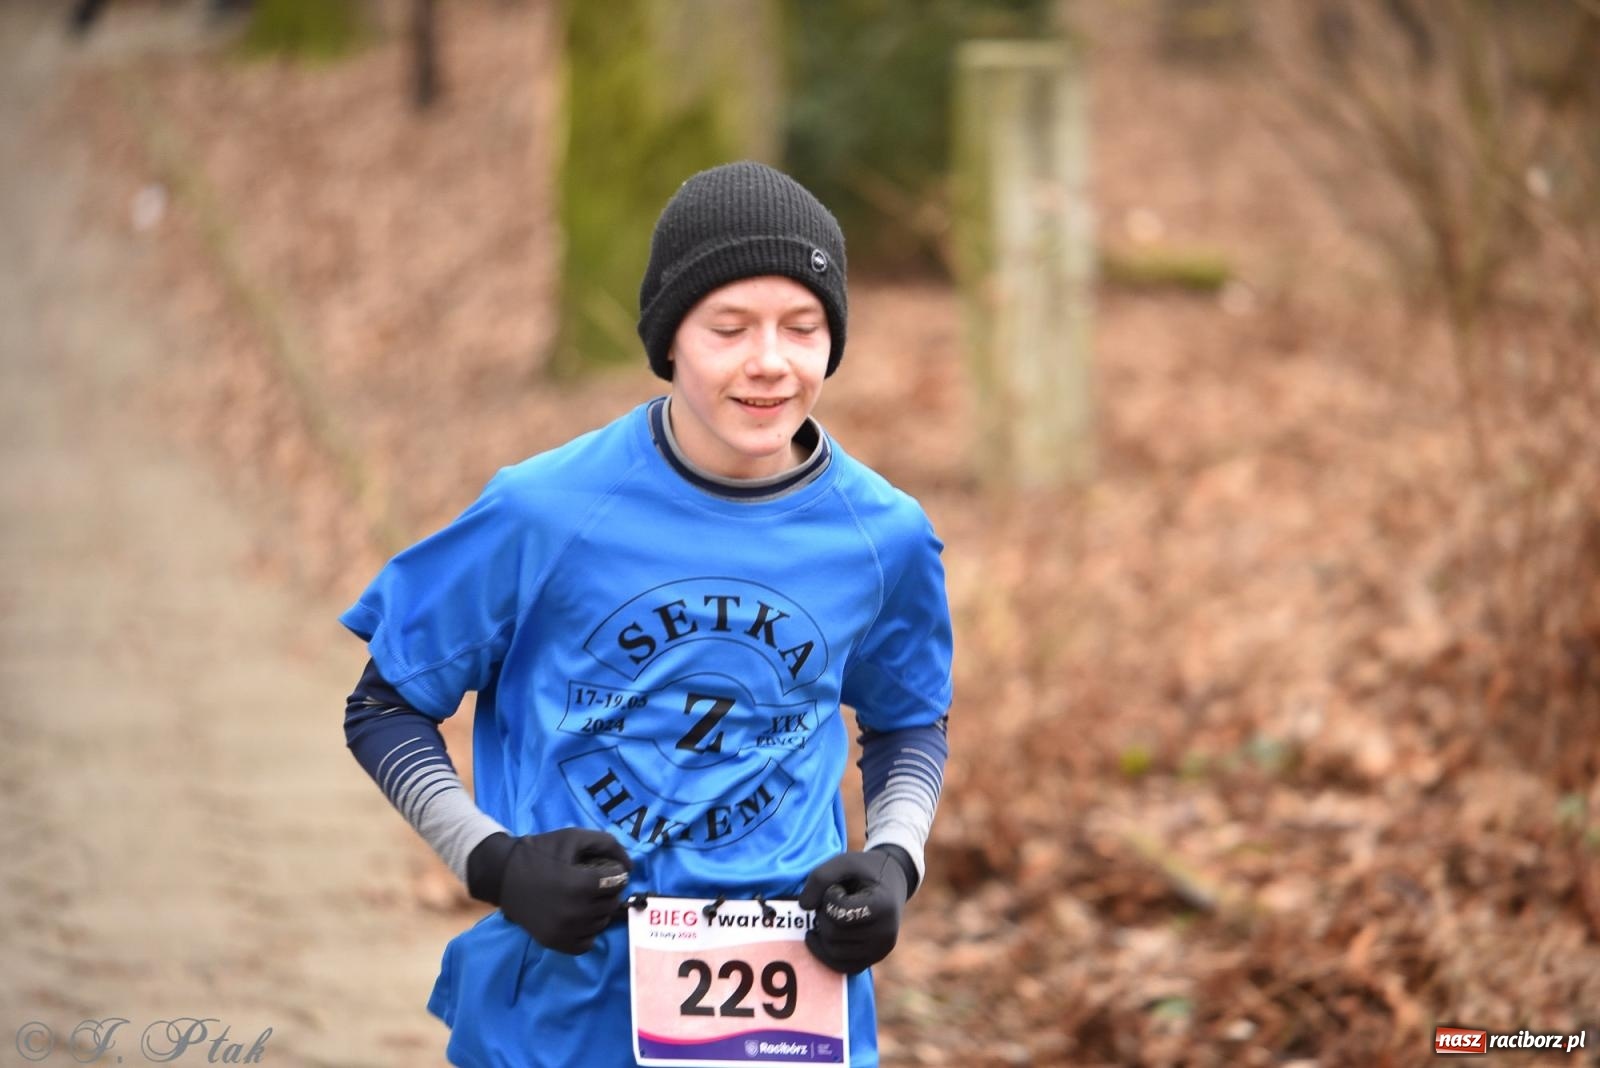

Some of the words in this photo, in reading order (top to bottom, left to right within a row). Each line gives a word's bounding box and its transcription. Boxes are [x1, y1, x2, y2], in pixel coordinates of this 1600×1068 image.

[617, 595, 815, 680] SETKA
[675, 692, 736, 754] Z
[650, 909, 698, 926] BIEG
[677, 958, 798, 1020] 229
